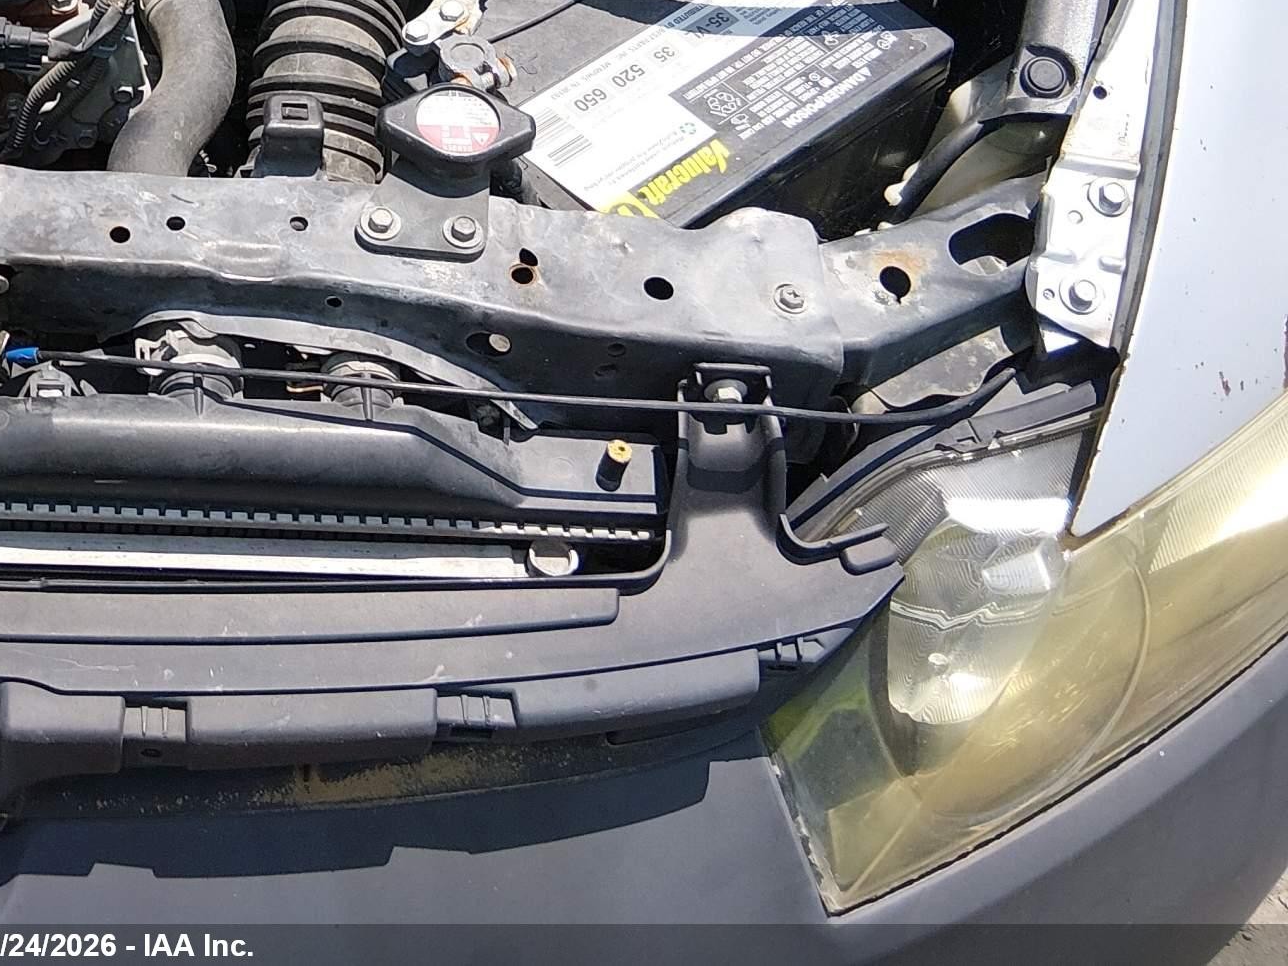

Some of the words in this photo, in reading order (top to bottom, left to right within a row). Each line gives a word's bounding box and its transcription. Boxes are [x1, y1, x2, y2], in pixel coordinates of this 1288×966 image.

[653, 46, 675, 63] 35
[612, 64, 645, 87] 520
[574, 88, 607, 111] 650
[637, 139, 730, 205] Valucraft
